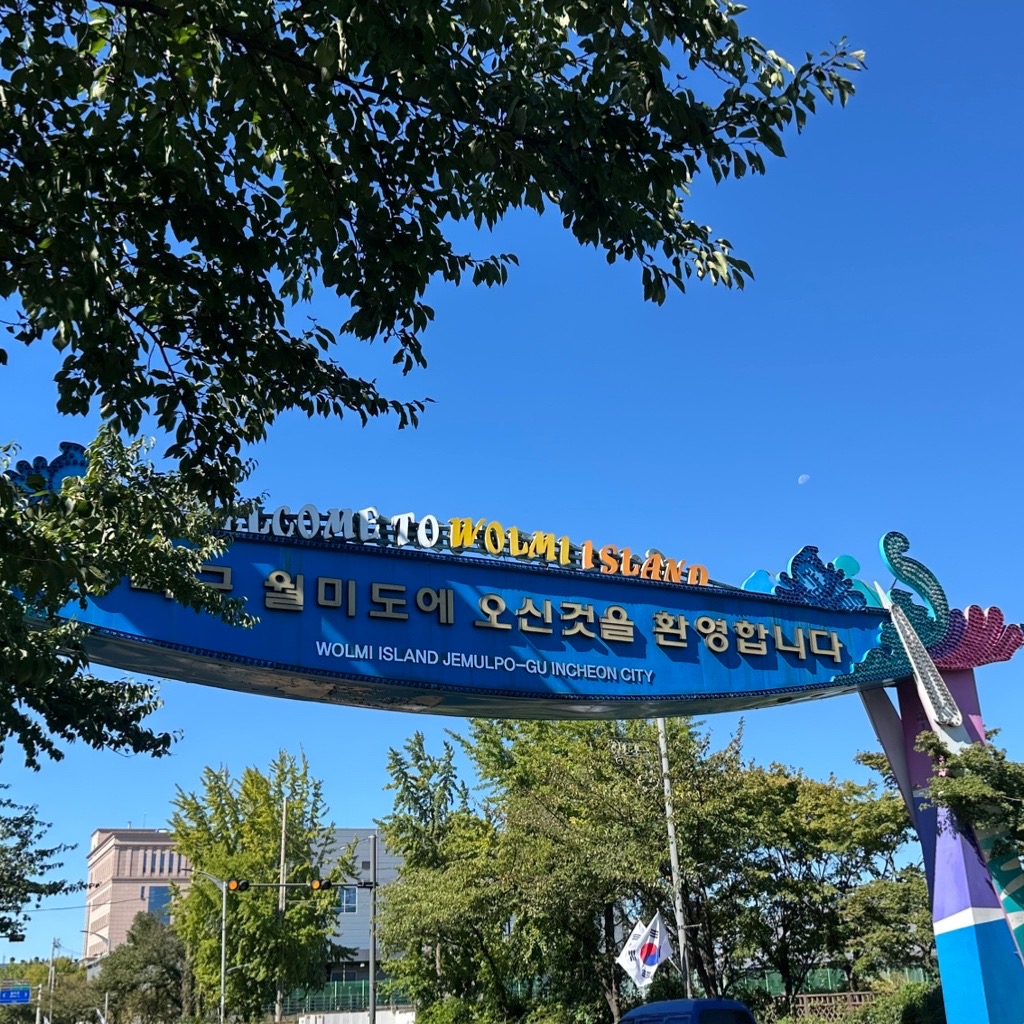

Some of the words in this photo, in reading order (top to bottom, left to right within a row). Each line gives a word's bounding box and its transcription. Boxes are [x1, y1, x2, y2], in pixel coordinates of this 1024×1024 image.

[222, 500, 379, 543] LCOME
[391, 511, 441, 549] TO
[449, 517, 571, 567] WOLMI
[581, 540, 709, 587] ISLAND
[264, 569, 454, 625] 월미도에
[475, 592, 635, 643] 오신것을
[652, 610, 843, 663] 환영합니다
[315, 640, 373, 660] WOLMI
[378, 646, 439, 665] ISLAND
[551, 661, 618, 681] INCHEON
[620, 667, 655, 683] CITY
